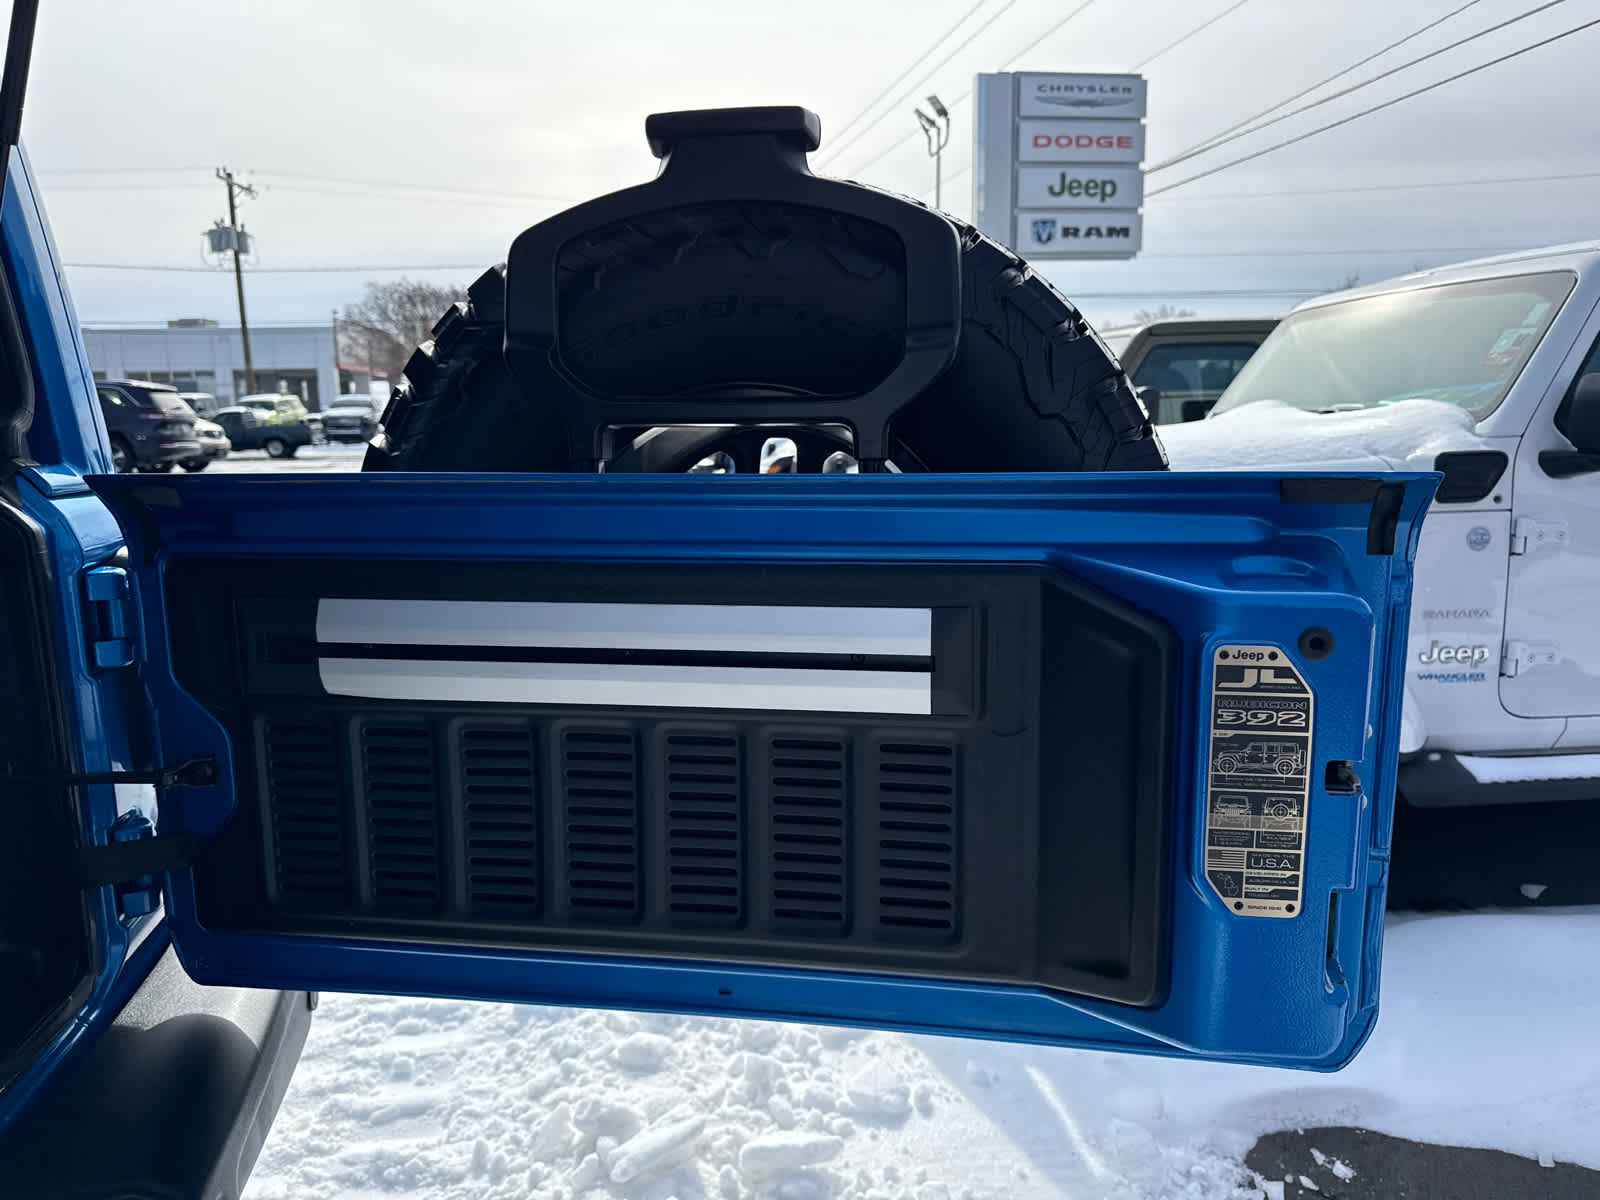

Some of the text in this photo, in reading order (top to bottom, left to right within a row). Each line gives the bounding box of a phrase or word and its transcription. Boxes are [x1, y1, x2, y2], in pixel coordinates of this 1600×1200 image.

[1037, 84, 1133, 95] CHRYSLER
[1033, 134, 1133, 149] DODGE
[1047, 171, 1117, 202] Jeep
[1061, 226, 1130, 239] RAM
[1232, 650, 1264, 661] Jeep
[1419, 640, 1489, 669] Jeep
[1218, 668, 1298, 689] JL
[1217, 709, 1306, 727] 392
